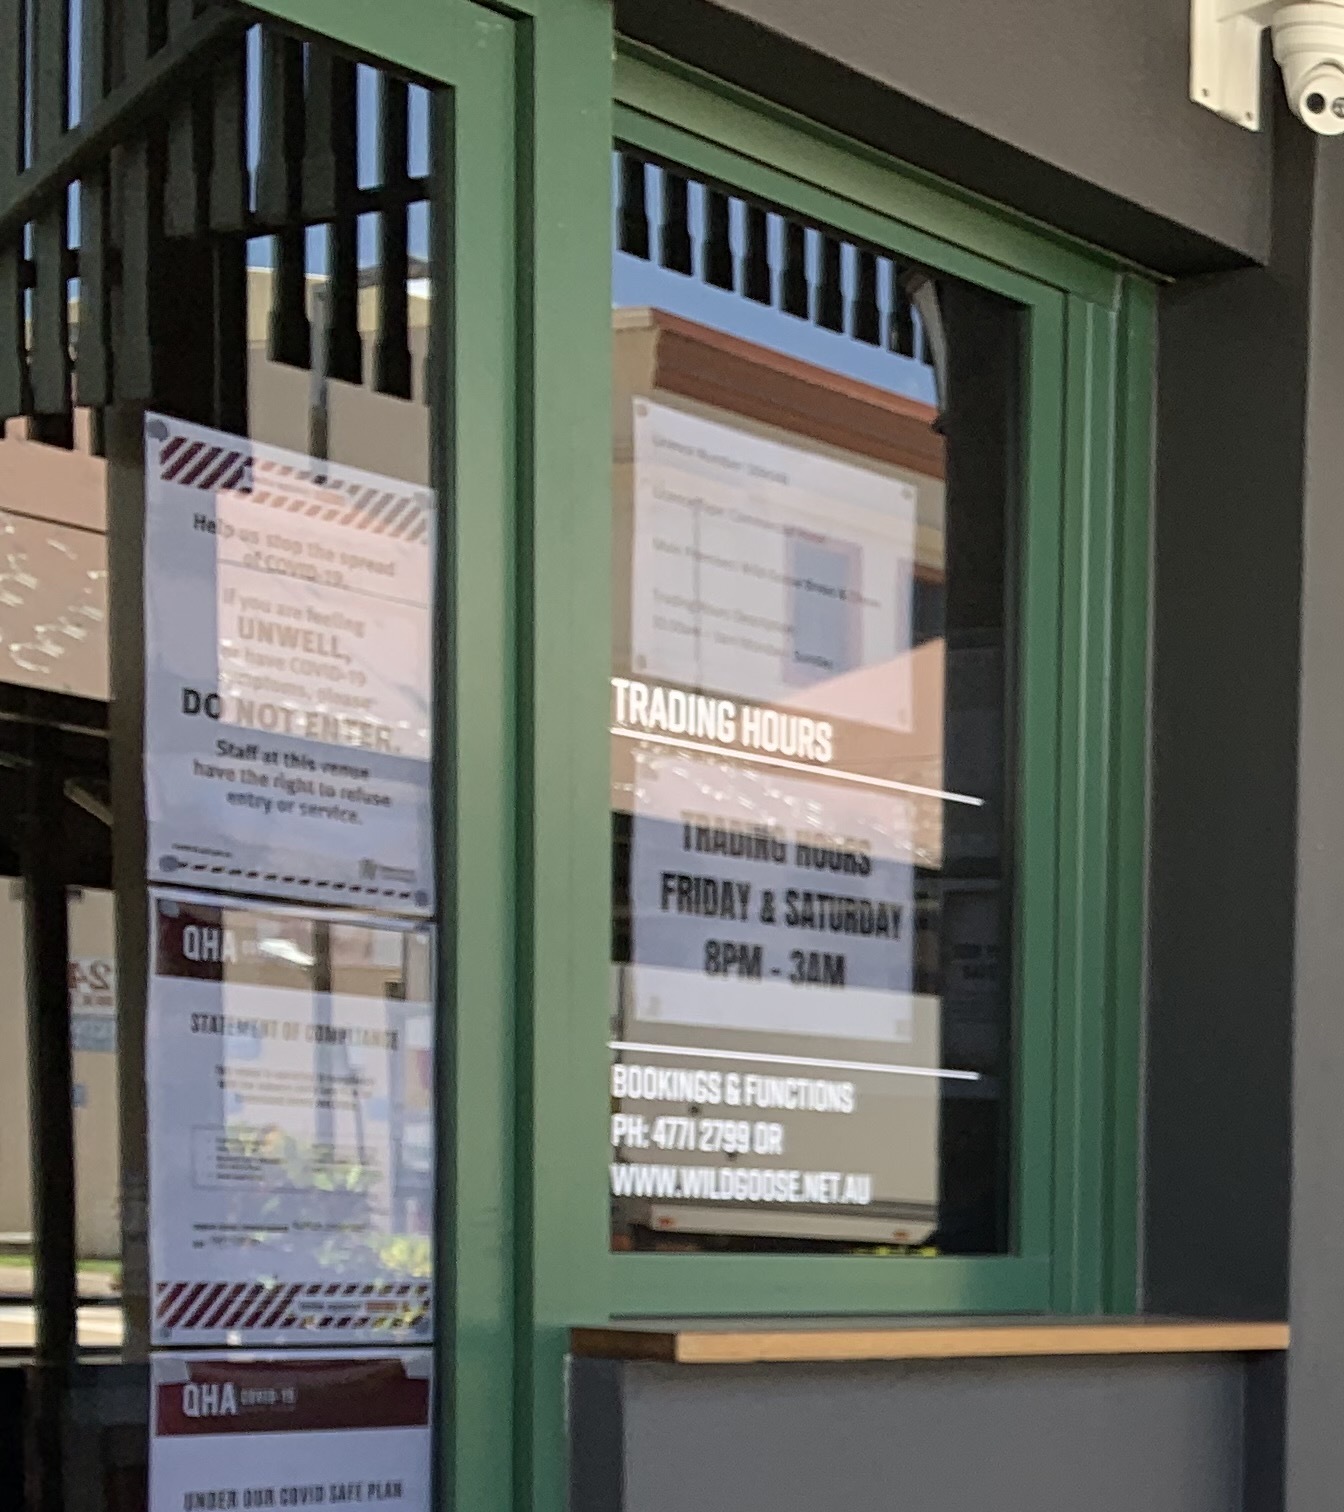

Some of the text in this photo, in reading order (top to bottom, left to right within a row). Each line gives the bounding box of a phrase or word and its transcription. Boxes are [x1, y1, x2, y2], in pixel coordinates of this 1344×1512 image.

[193, 511, 235, 539] Help
[238, 616, 352, 665] UNWELL,
[182, 687, 222, 721] DO
[236, 699, 294, 733] NOT
[610, 677, 834, 764] TRADING HOURS
[193, 758, 237, 783] have
[240, 767, 269, 788] the
[274, 772, 315, 796] right
[216, 739, 258, 762] Staff
[283, 751, 317, 772] this
[680, 809, 872, 878] TRADING HOURS
[660, 869, 905, 942] FRIDAY & SATURDAY
[703, 937, 764, 982] 8PM
[789, 947, 847, 988] 3AM
[611, 1063, 856, 1114] BOOKINGS & FUNCTIONS
[611, 1113, 785, 1155] PH: 4771 2799 OR
[609, 1161, 874, 1206] WWW.WILDGOOSE.NET.AU
[182, 1382, 241, 1418] QHA
[183, 1478, 403, 1512] UNDER OUR COVID SAFE PLAN
